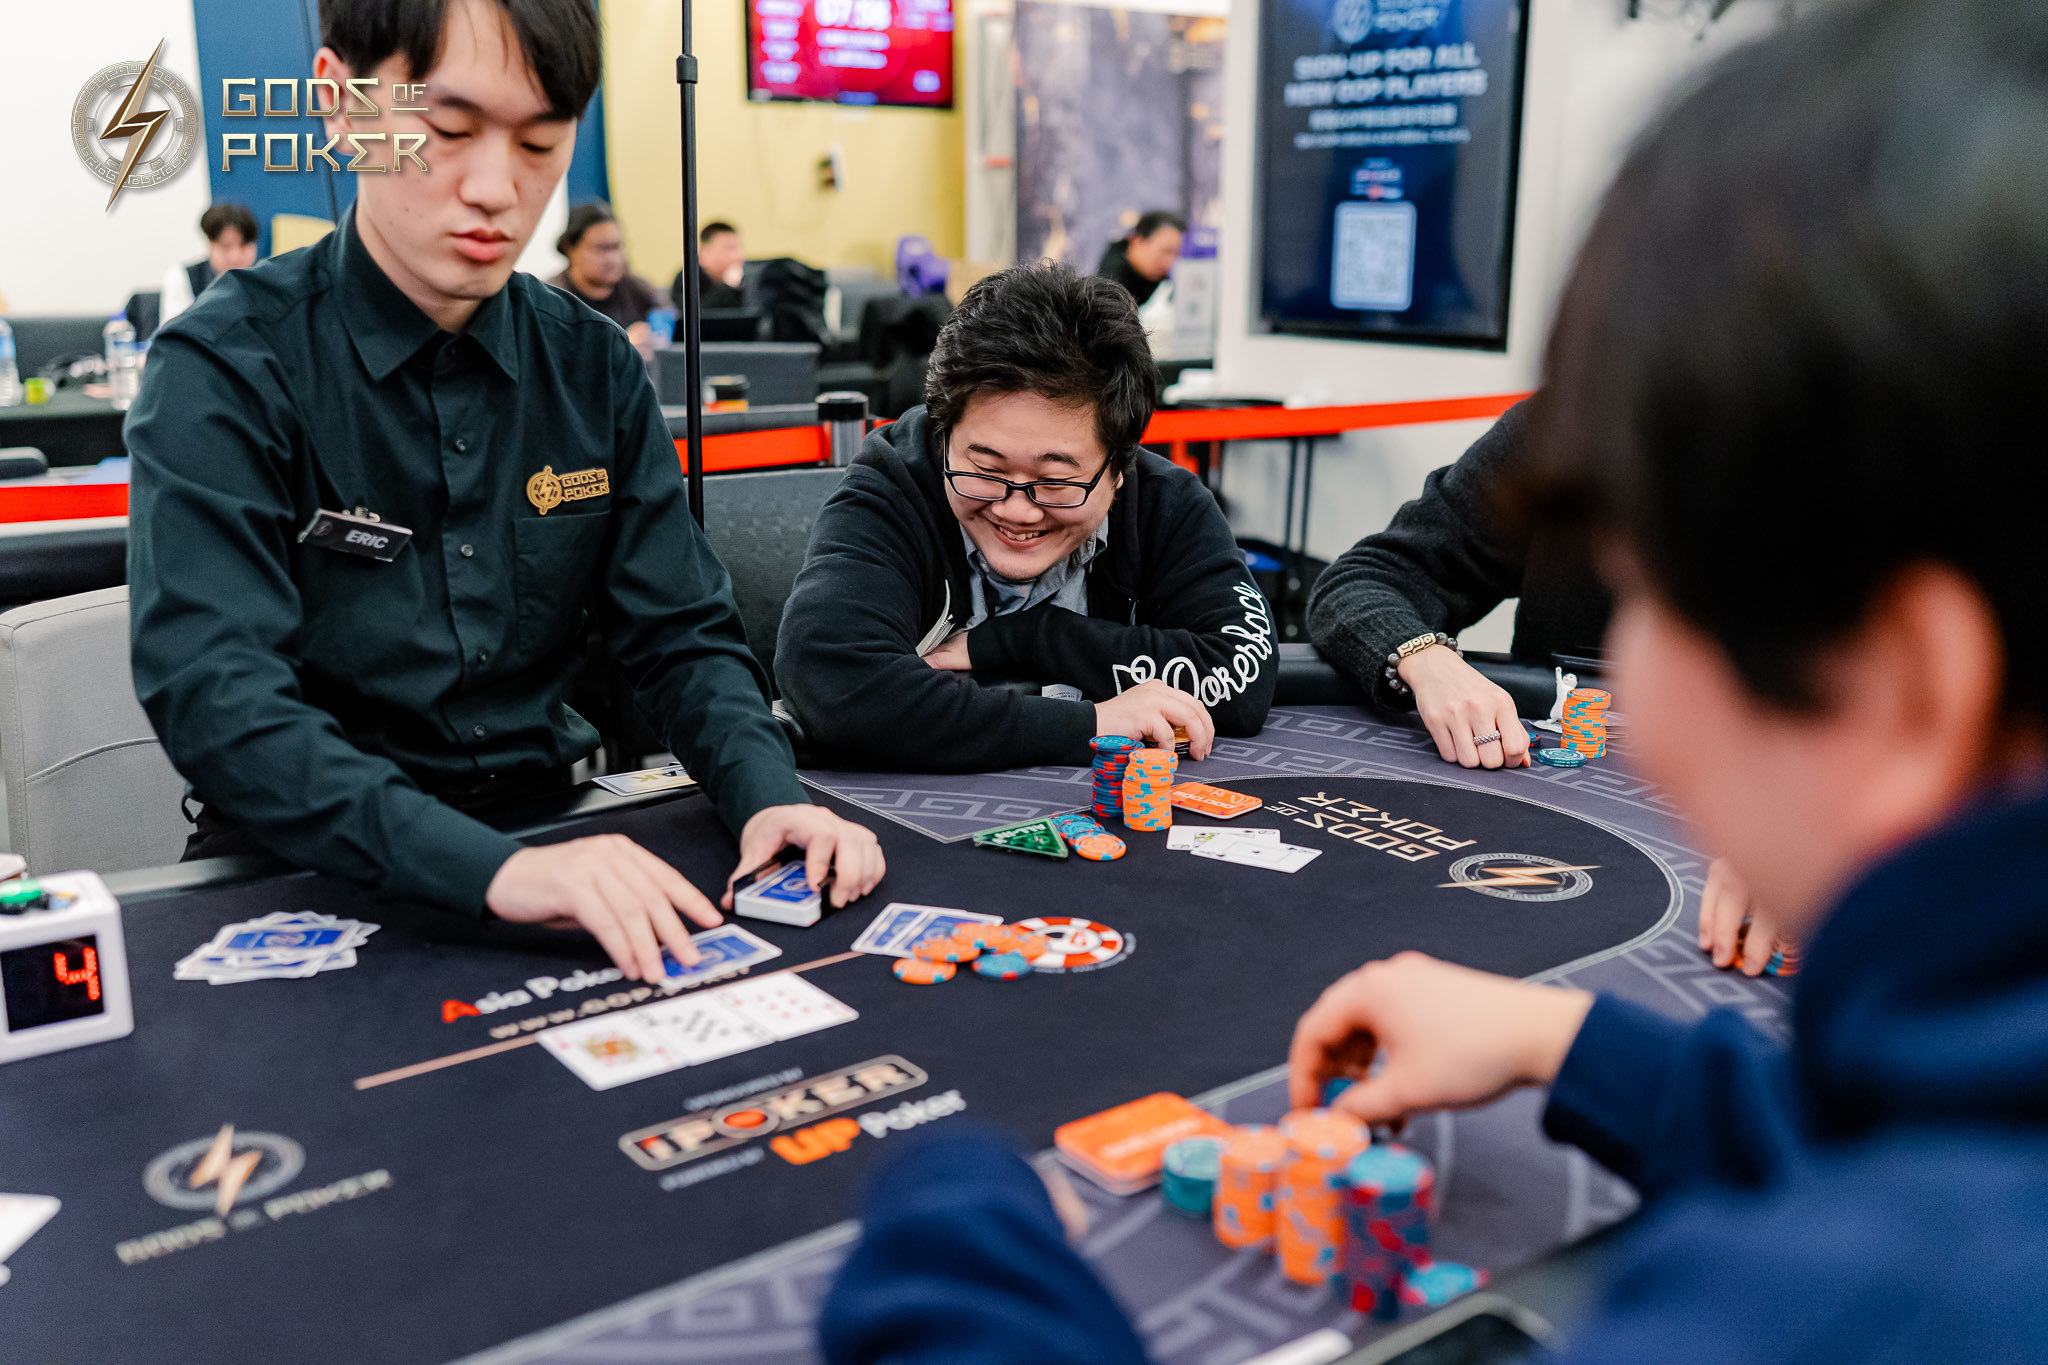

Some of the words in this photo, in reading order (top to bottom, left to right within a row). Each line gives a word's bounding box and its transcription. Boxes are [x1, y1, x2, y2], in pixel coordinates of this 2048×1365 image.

[562, 472, 598, 487] GODS
[564, 482, 608, 499] POKER
[345, 529, 389, 549] ERIC
[1297, 791, 1478, 850] POKER
[1293, 813, 1440, 862] GODS
[53, 947, 100, 1001] 4
[525, 967, 625, 999] Poke
